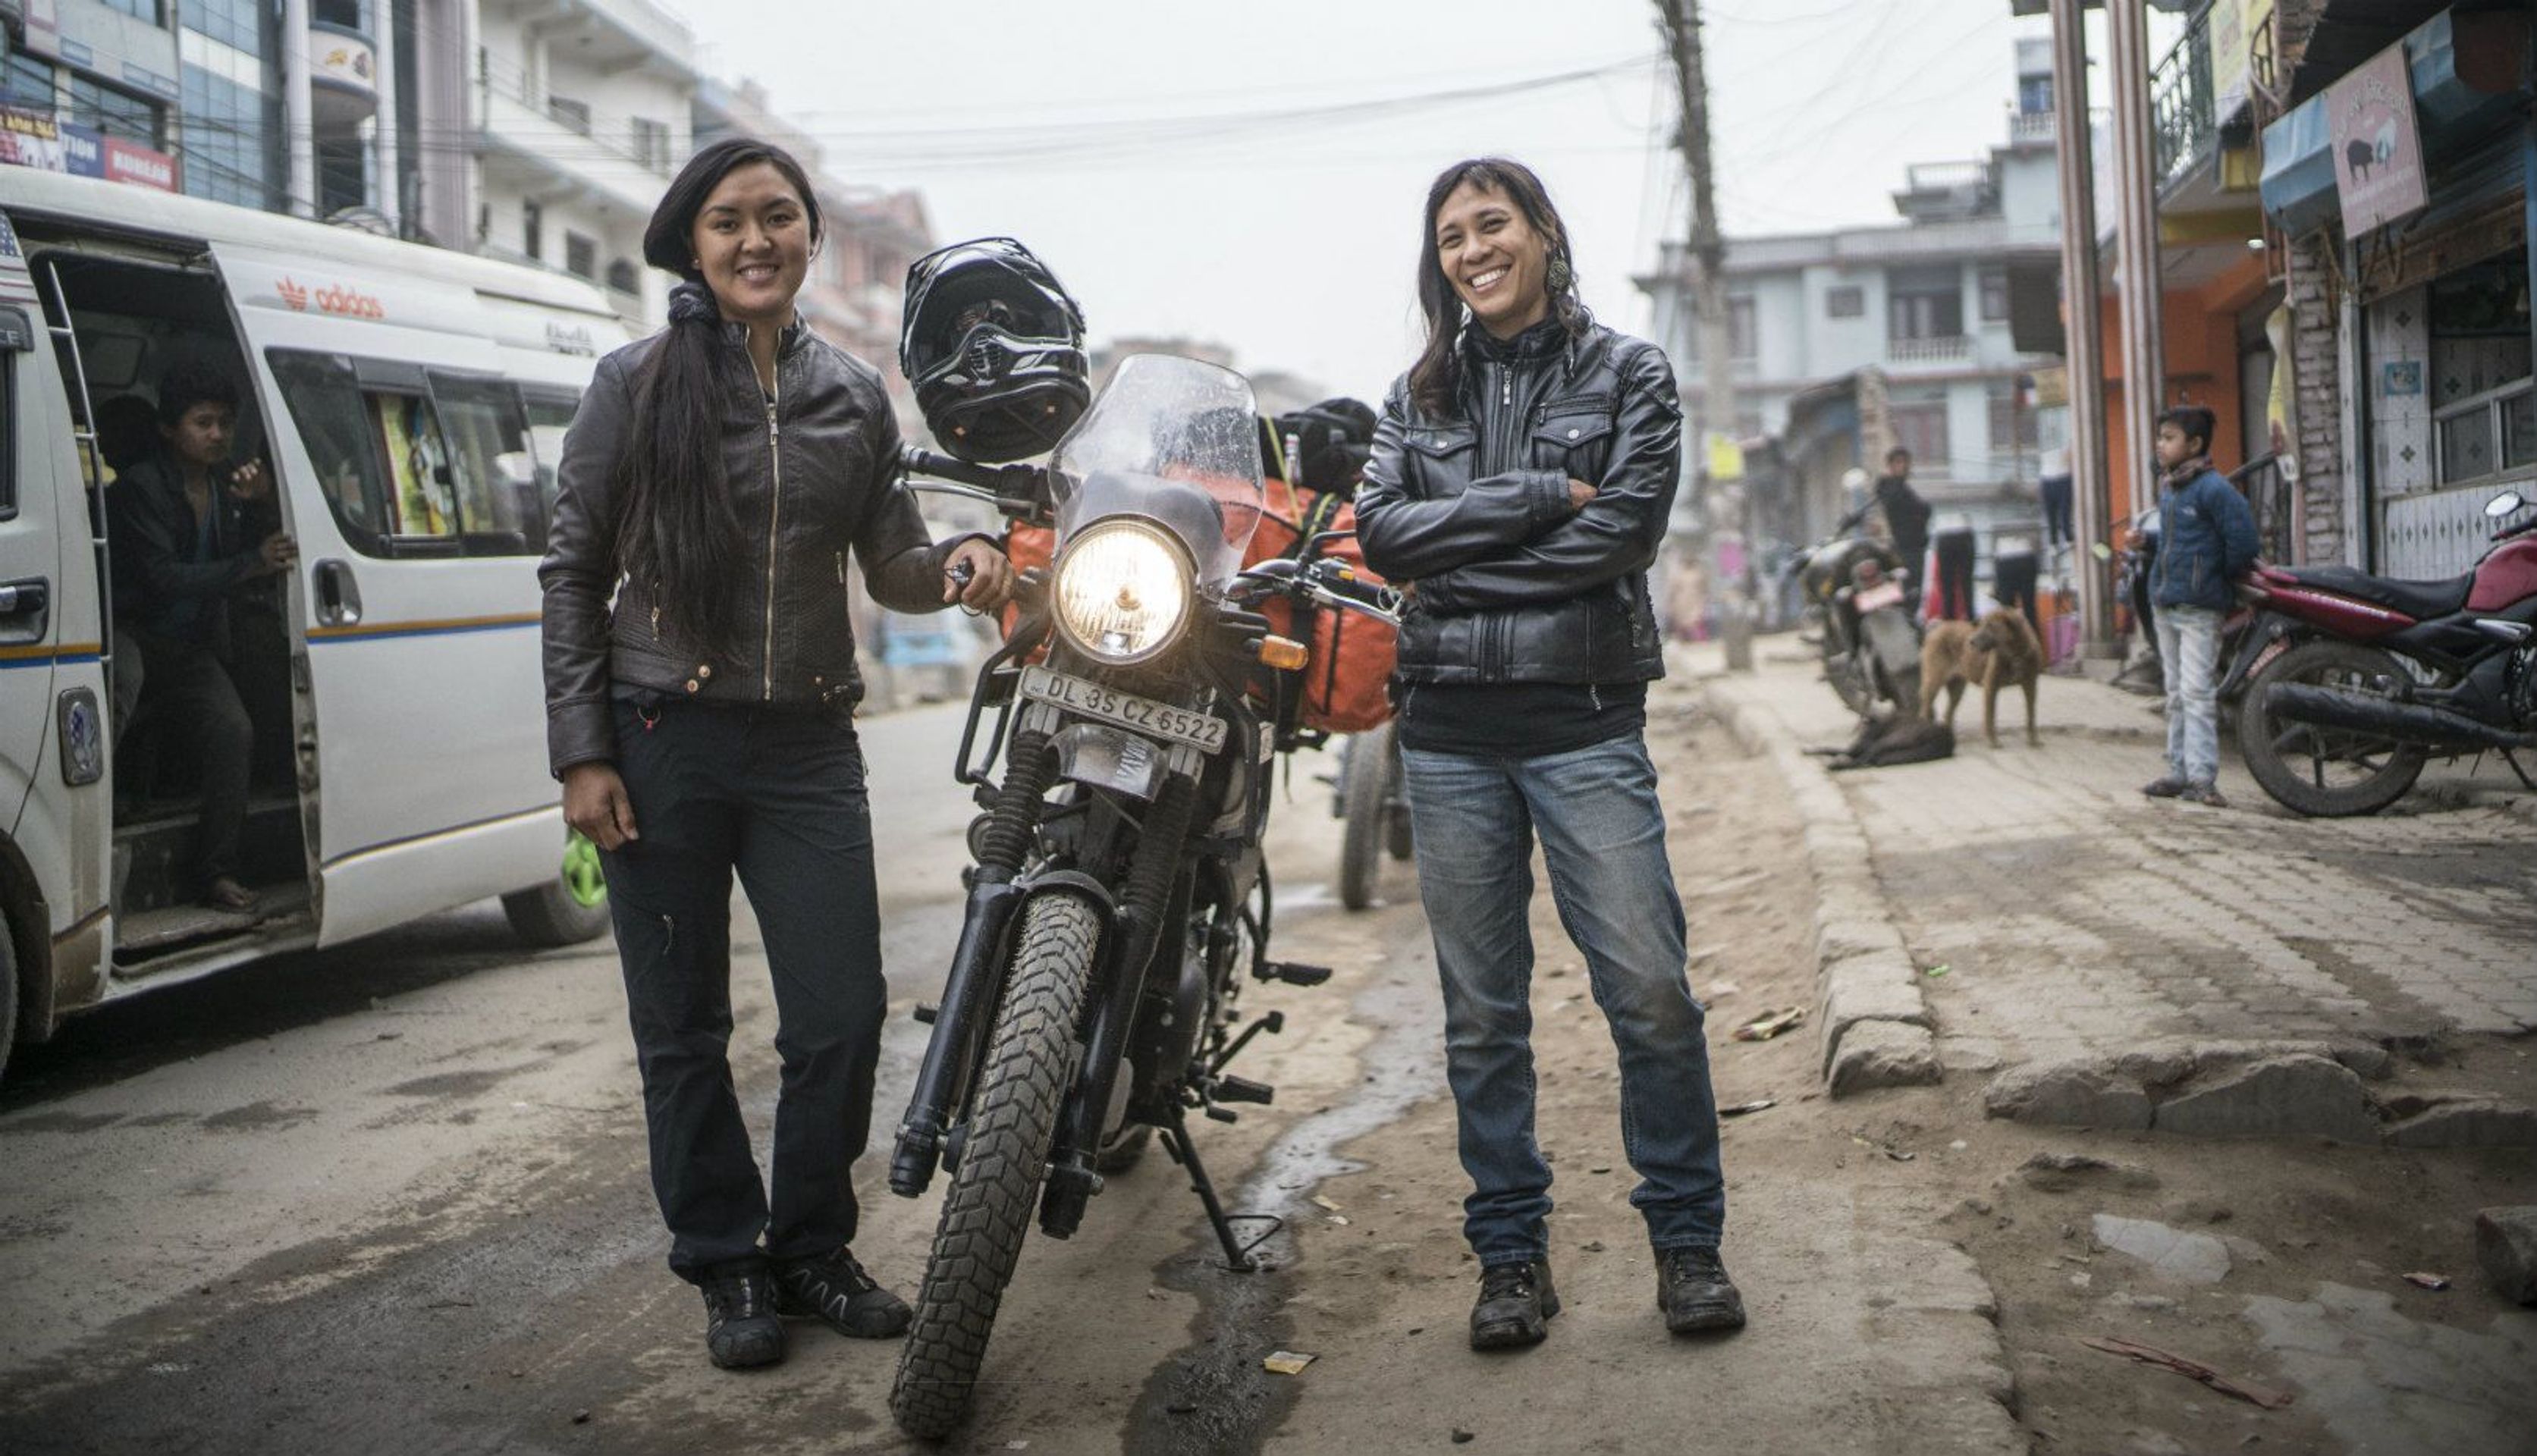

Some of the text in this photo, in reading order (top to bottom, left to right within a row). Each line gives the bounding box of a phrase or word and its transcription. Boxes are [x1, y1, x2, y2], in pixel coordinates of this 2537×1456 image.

[316, 284, 385, 318] adidas
[1048, 676, 1075, 703] DL
[1086, 689, 1116, 713] 3S
[1123, 700, 1154, 725] CZ
[1159, 711, 1219, 743] 6522
